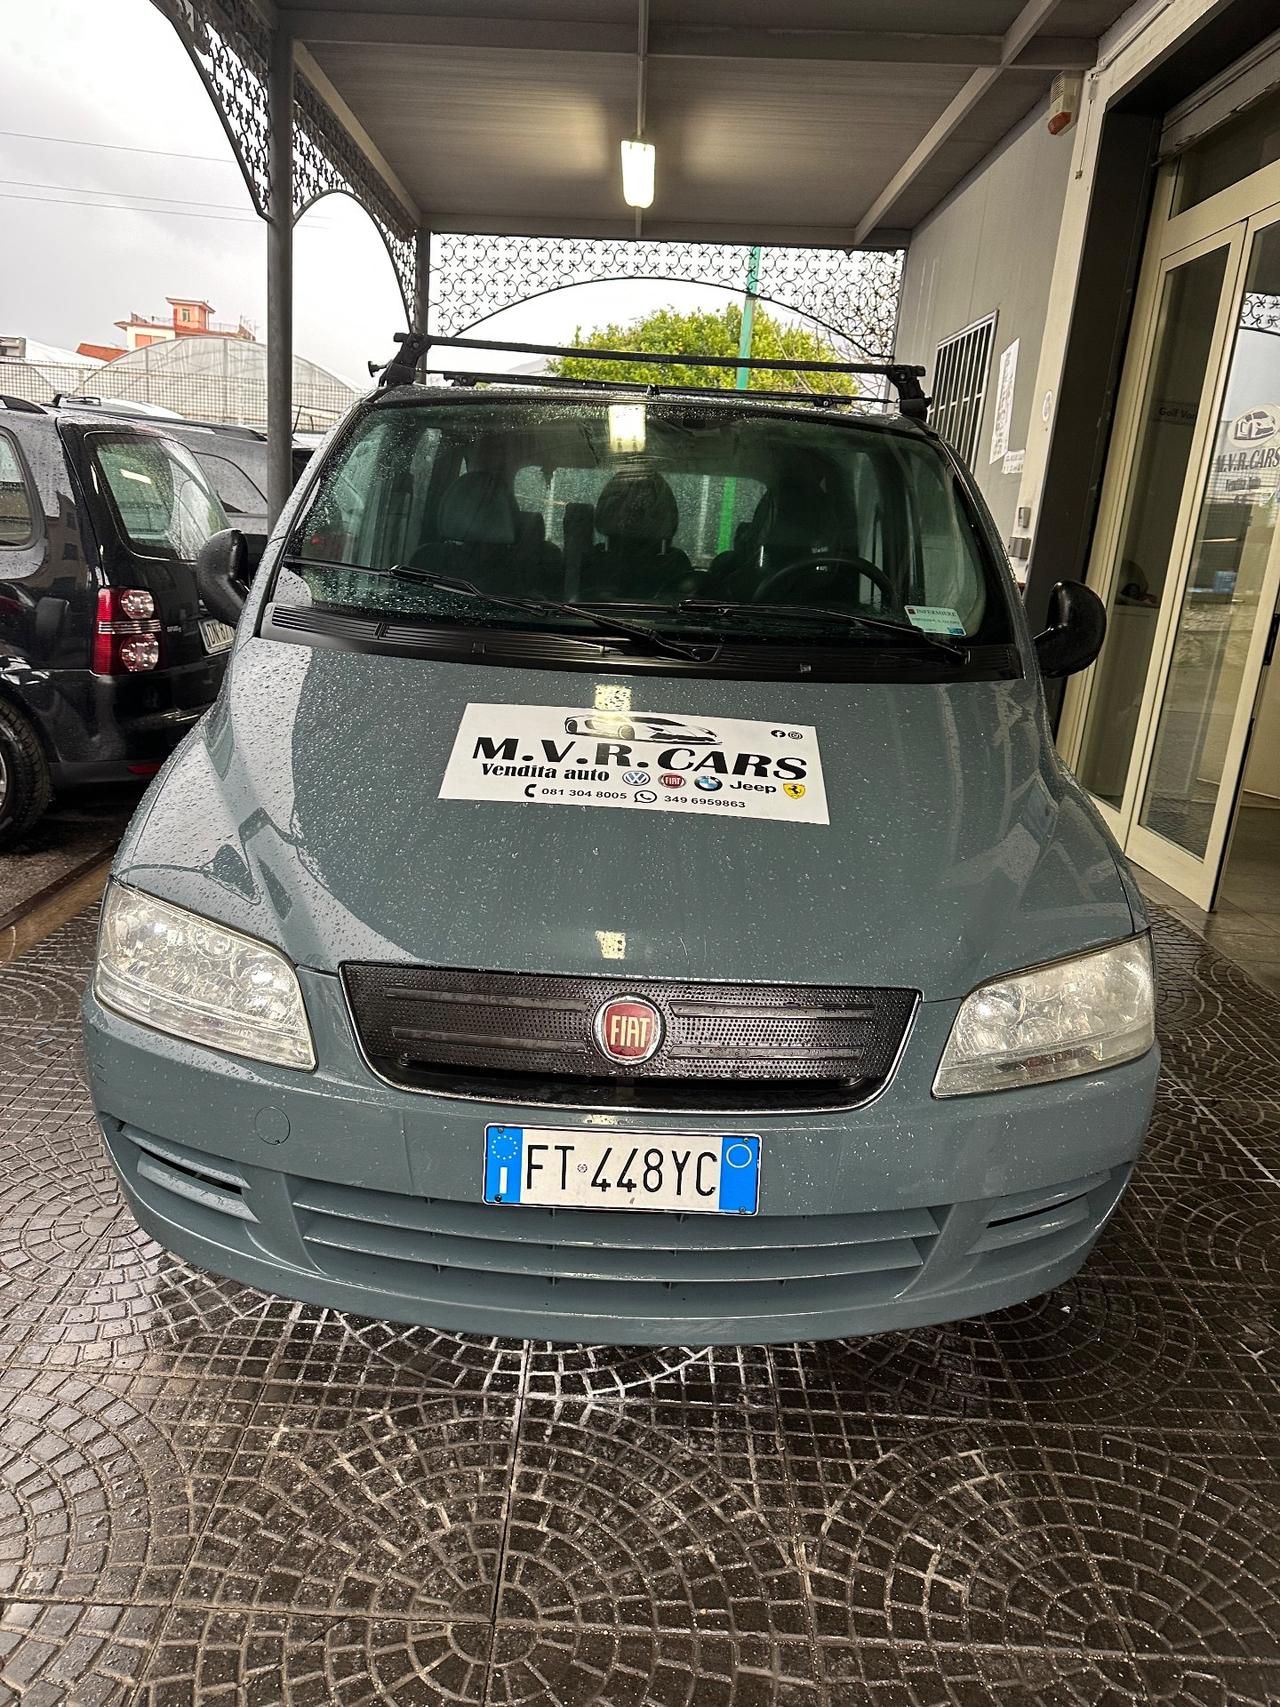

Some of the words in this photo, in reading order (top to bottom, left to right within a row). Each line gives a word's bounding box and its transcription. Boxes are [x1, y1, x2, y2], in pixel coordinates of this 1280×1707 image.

[481, 762, 558, 779] Vendita
[563, 768, 610, 782] auto
[664, 775, 682, 786] FIAT
[730, 780, 777, 795] Jeep
[541, 787, 564, 796] 081
[569, 789, 592, 798] 304
[595, 791, 627, 800] 8005
[664, 795, 687, 804] 349
[690, 797, 746, 808] 6959863
[610, 1014, 651, 1048] FIAT
[526, 1143, 575, 1191] FT
[590, 1147, 718, 1197] 448YC
